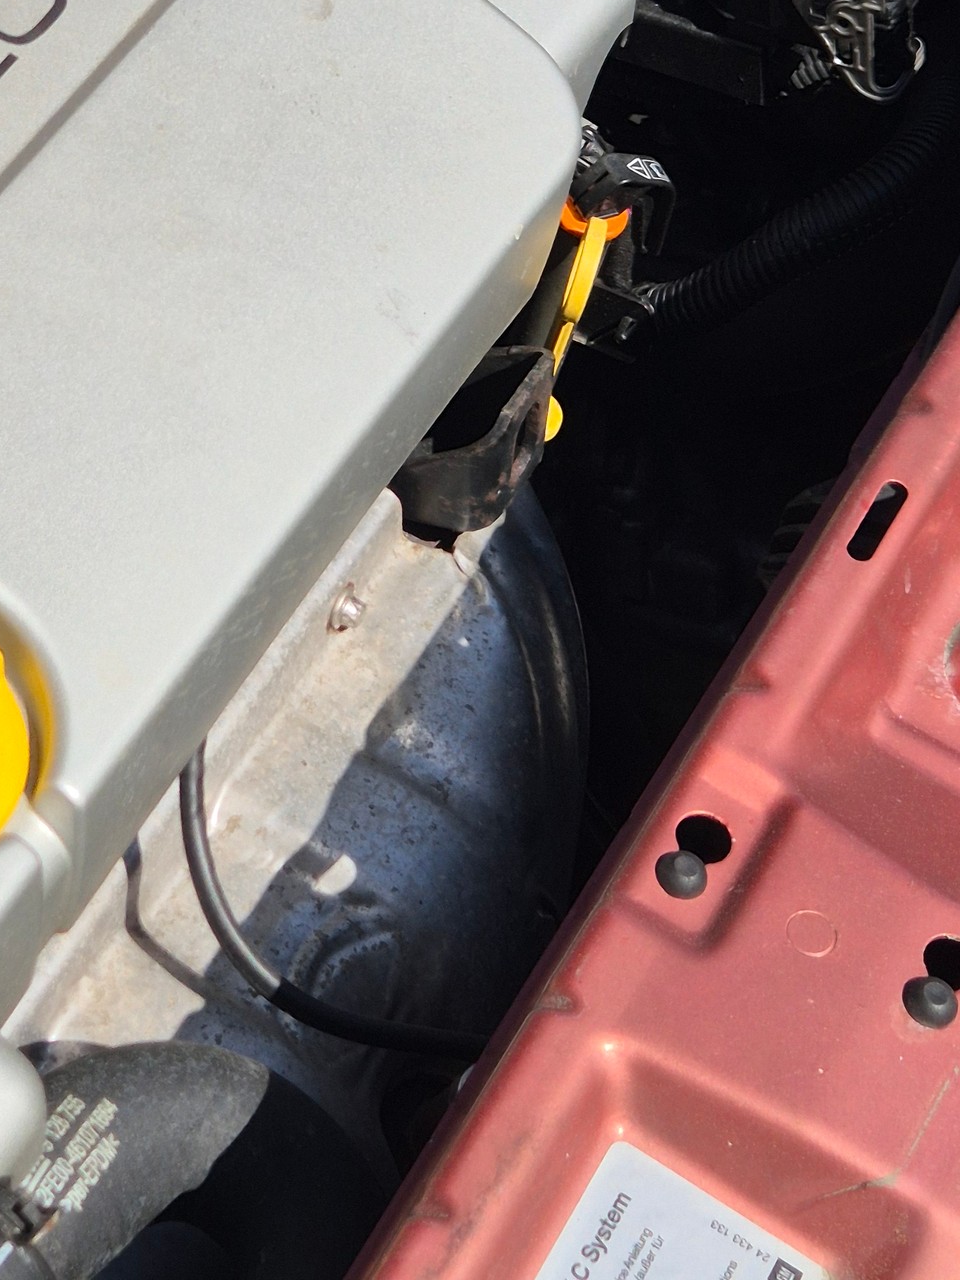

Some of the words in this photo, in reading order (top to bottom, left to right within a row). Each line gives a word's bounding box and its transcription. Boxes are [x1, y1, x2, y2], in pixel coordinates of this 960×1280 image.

[566, 1262, 590, 1280] C
[581, 1192, 632, 1263] System
[710, 1219, 728, 1236] 133
[623, 1228, 653, 1270] Anleitung
[651, 1235, 664, 1250] für
[732, 1233, 753, 1250] 433
[756, 1249, 770, 1262] 24
